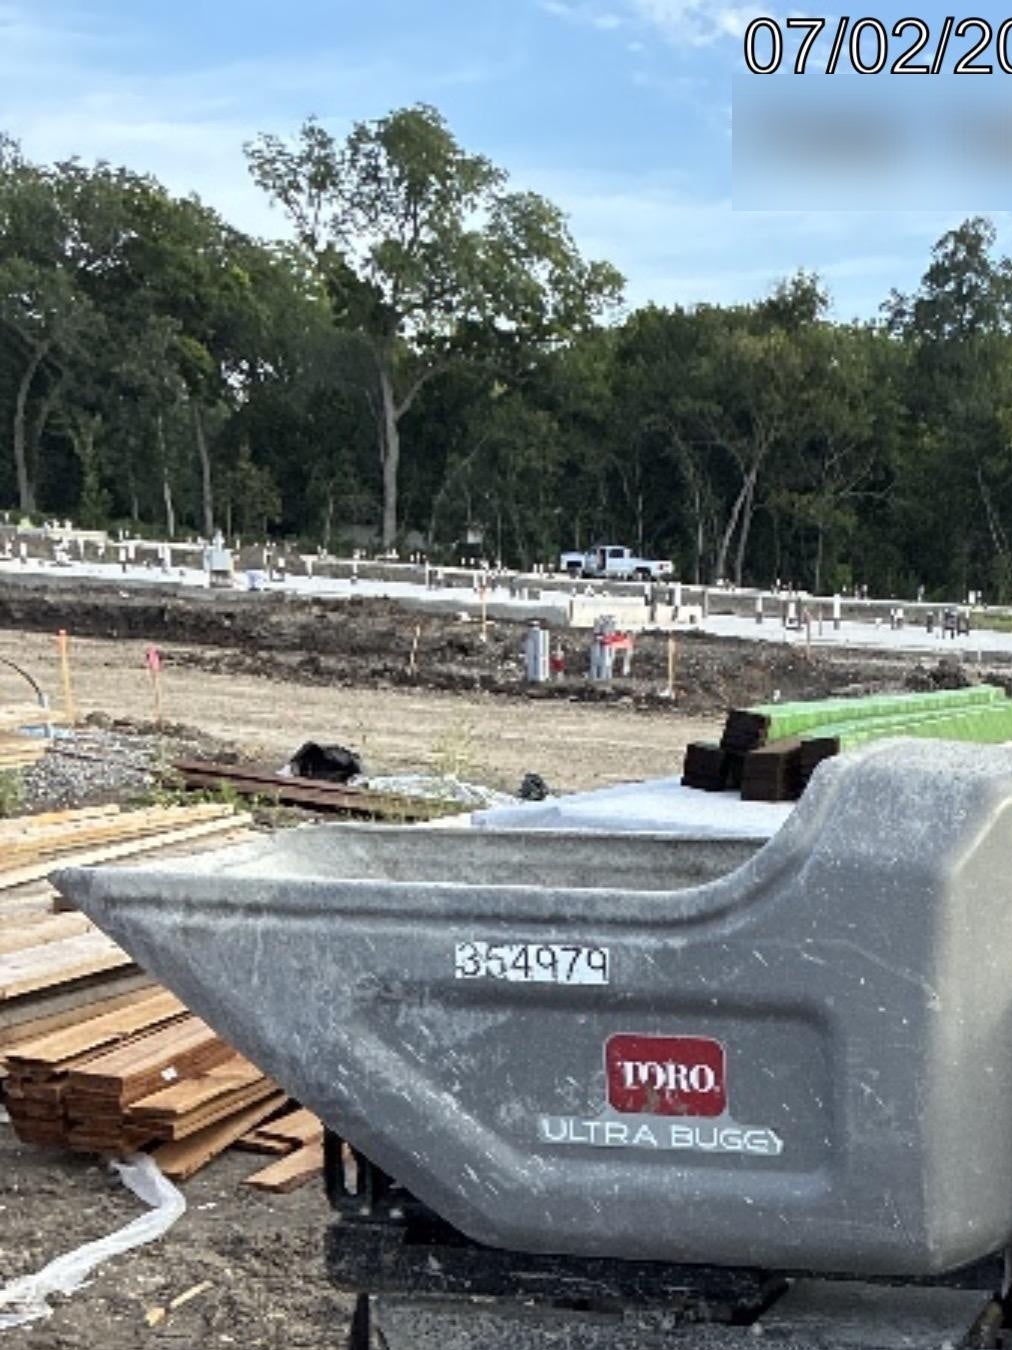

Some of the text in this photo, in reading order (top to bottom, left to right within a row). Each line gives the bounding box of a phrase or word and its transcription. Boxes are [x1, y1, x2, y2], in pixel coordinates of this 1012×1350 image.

[455, 942, 609, 982] 354979
[616, 1060, 716, 1094] TORO
[540, 1117, 658, 1147] ULTRA
